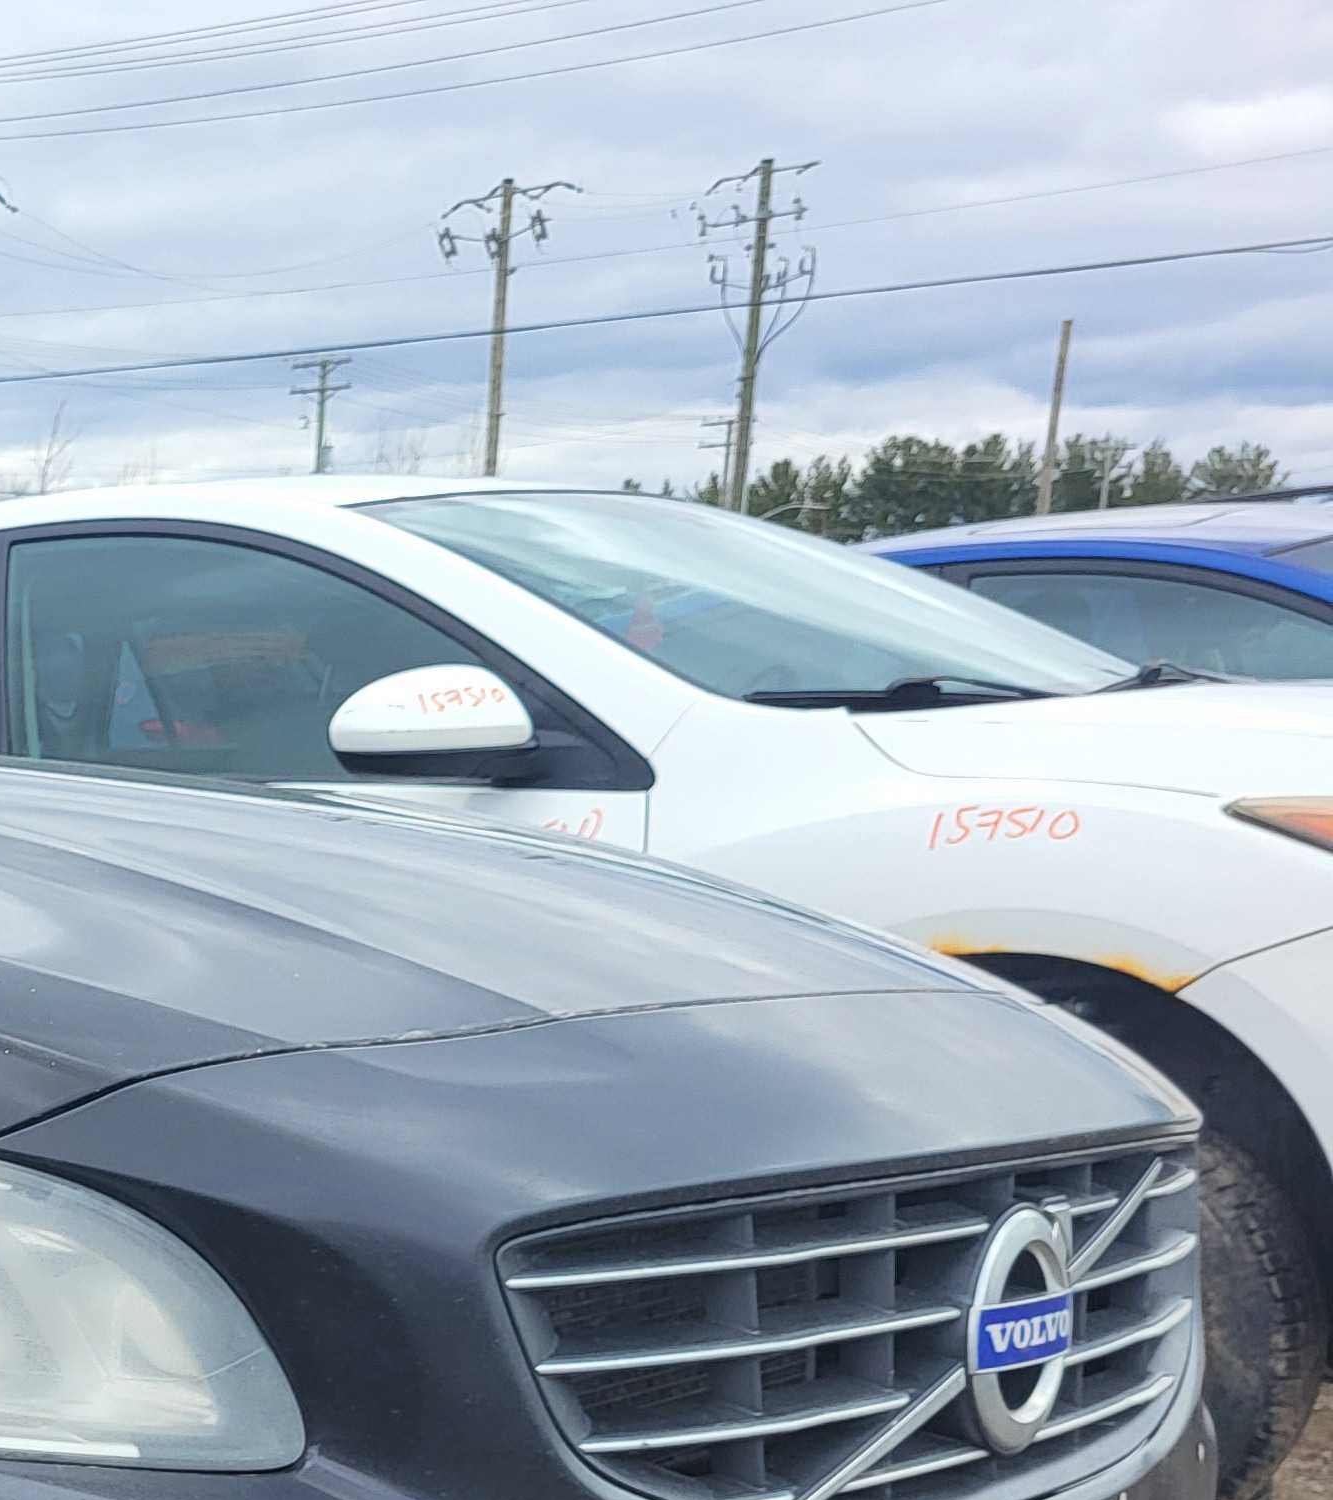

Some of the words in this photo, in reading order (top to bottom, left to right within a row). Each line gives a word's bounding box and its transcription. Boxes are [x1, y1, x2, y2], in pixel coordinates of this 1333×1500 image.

[418, 686, 505, 713] 157510
[928, 804, 1080, 850] 157510
[985, 1309, 1071, 1353] VOLVO
